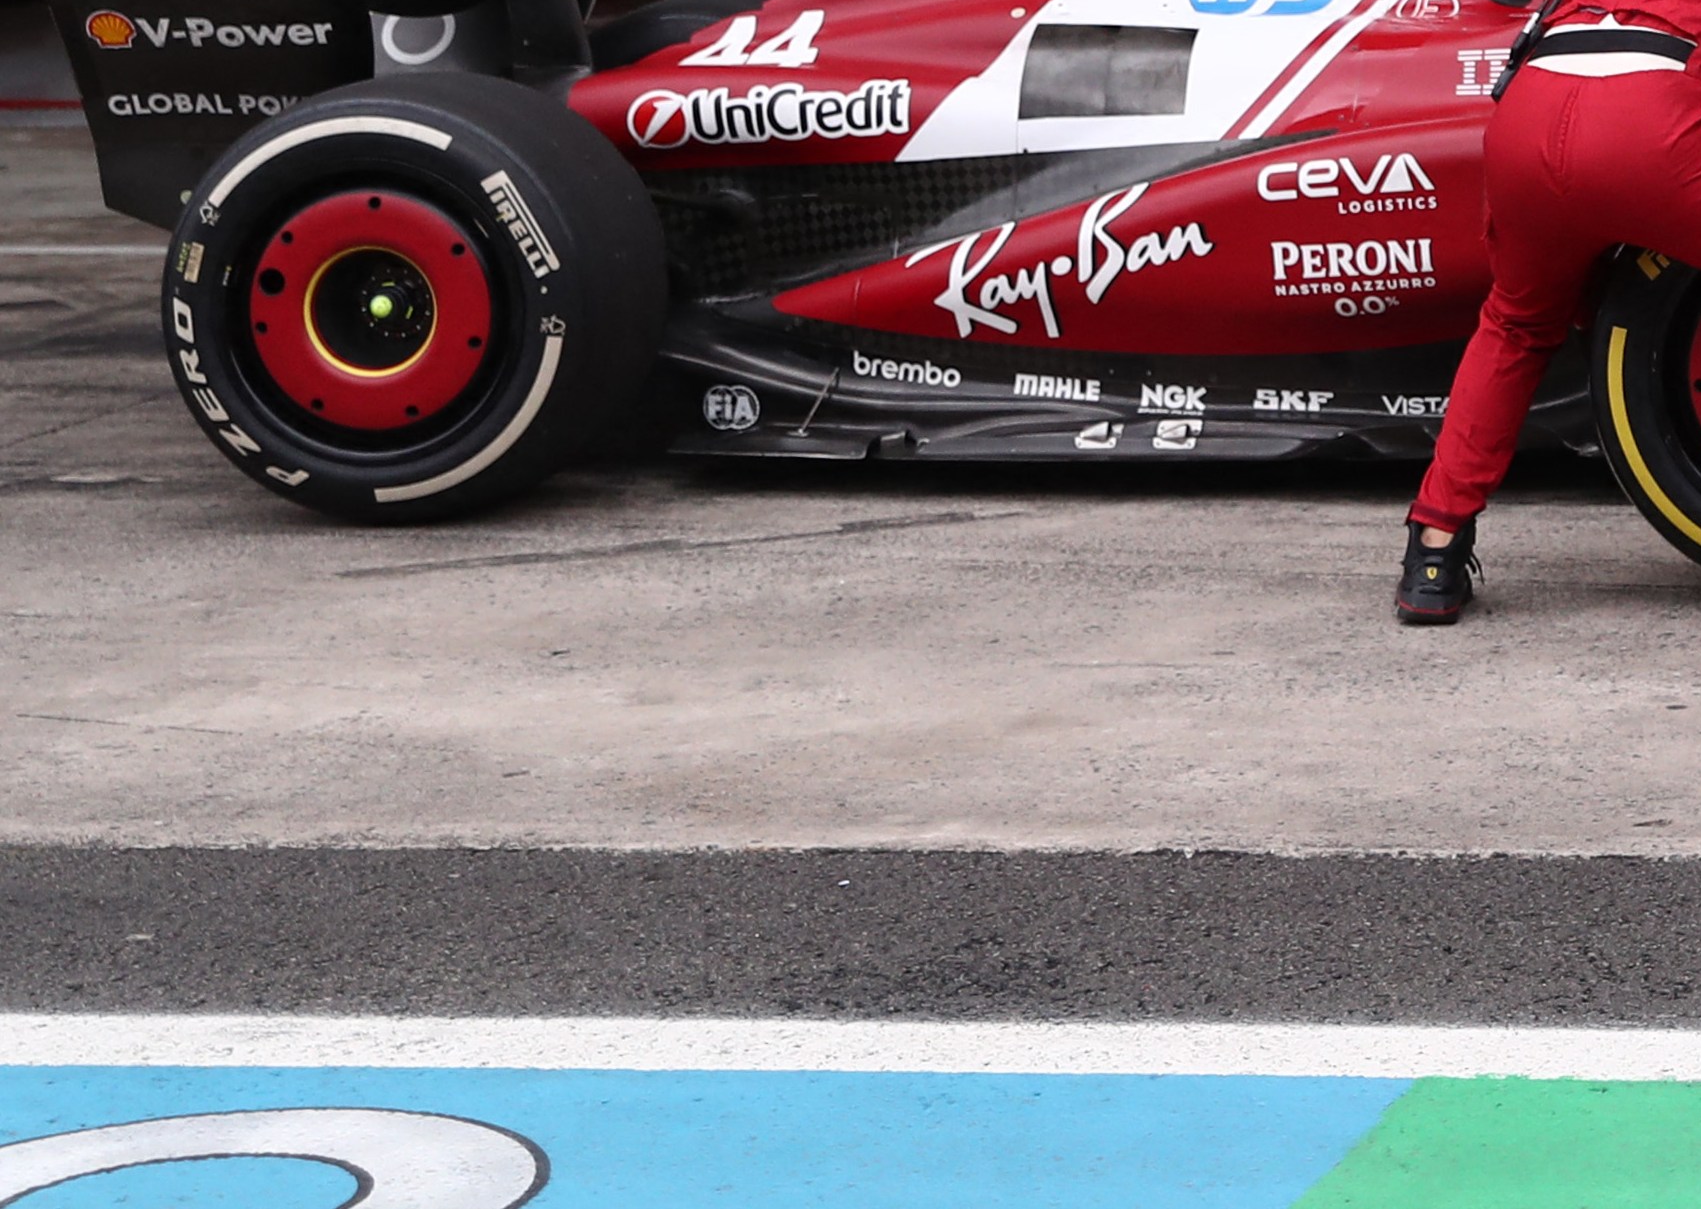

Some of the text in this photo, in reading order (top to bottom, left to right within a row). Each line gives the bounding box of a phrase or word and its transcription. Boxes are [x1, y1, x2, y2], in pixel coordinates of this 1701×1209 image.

[135, 16, 334, 50] V-Power
[679, 9, 825, 68] 44
[107, 94, 308, 118] GLOBAL POK
[691, 79, 911, 143] UniCredit
[1337, 196, 1439, 215] LOGISTICS
[481, 170, 561, 279] PIRELLI
[1270, 238, 1436, 281] PERONI
[1274, 277, 1438, 297] NASTRO AZZURRO
[1333, 294, 1402, 318] 0.0%
[172, 296, 263, 457] ZERO
[852, 350, 962, 389] brembo
[1013, 373, 1102, 404] MAHLE
[1139, 383, 1208, 411] NGK
[1252, 388, 1335, 413] SKF
